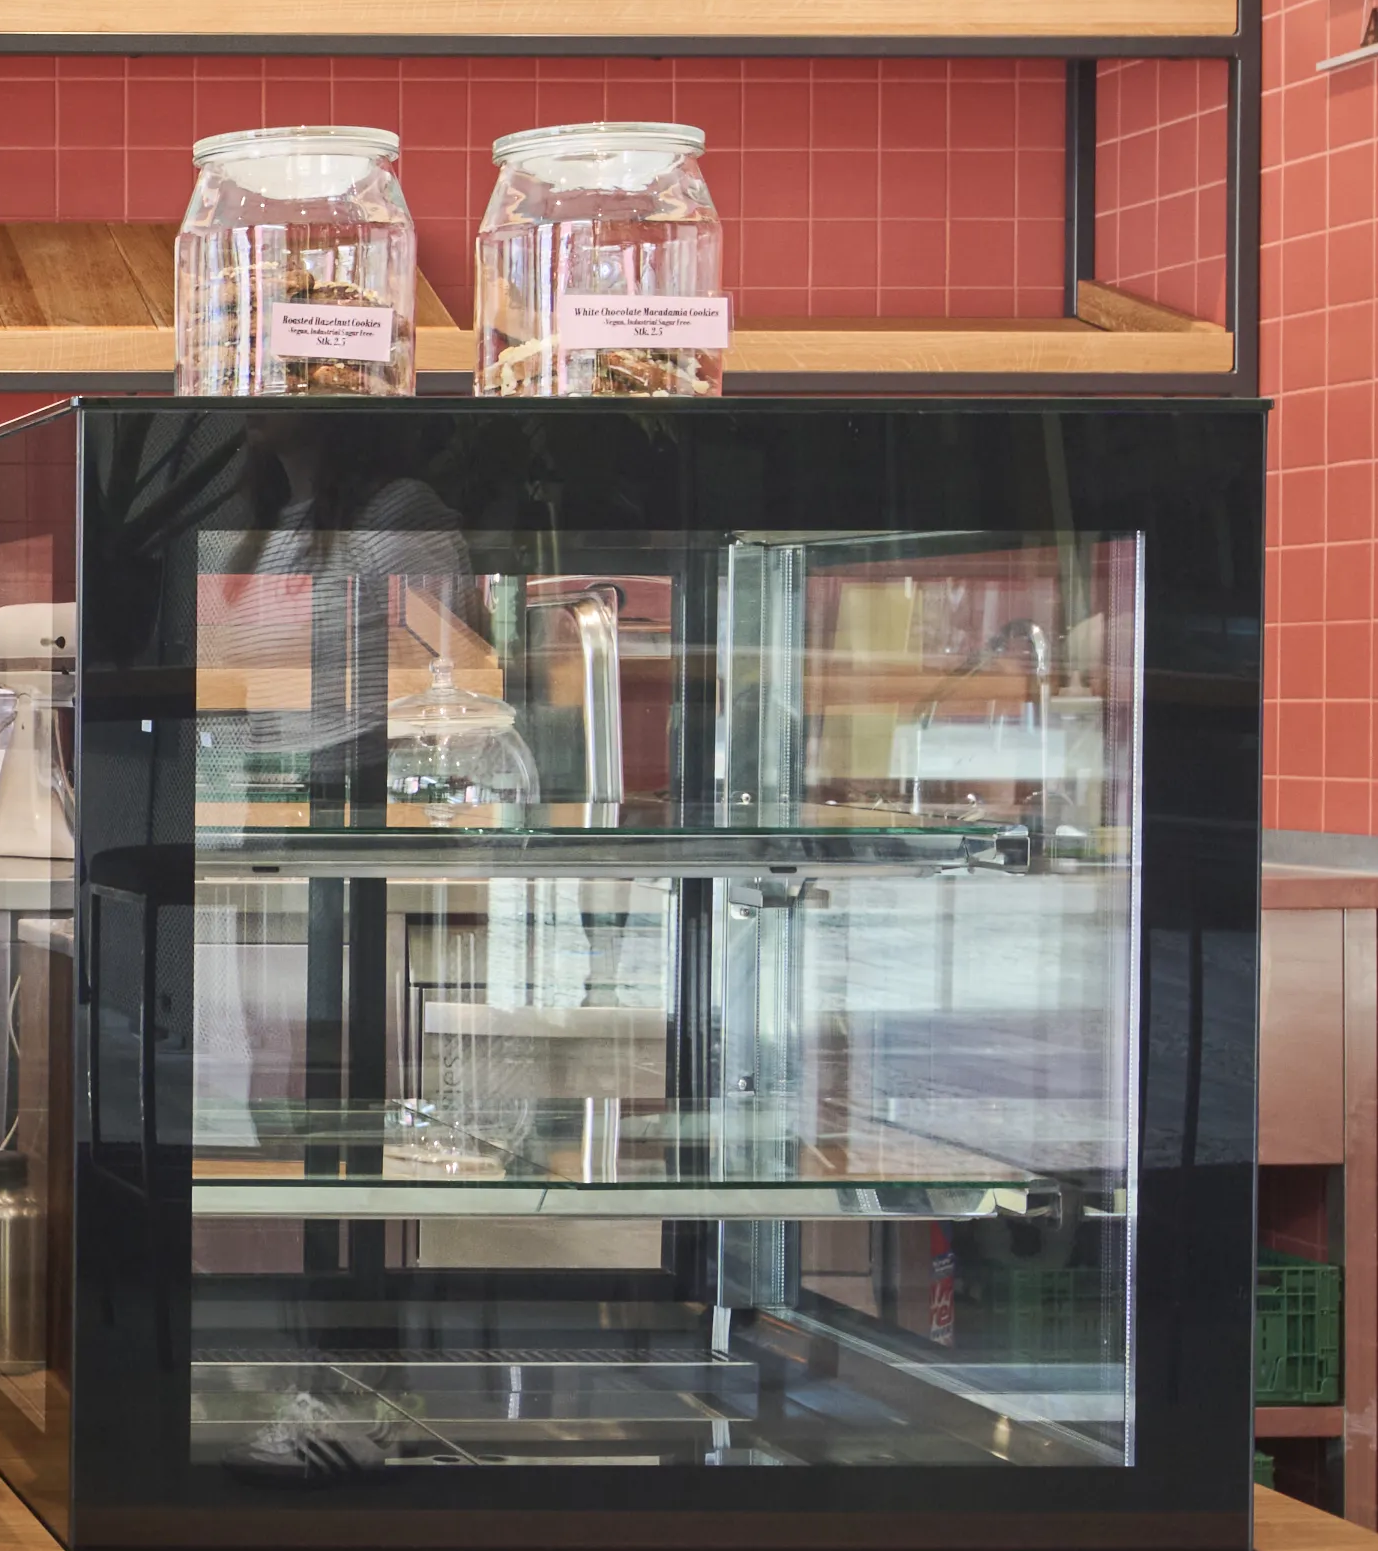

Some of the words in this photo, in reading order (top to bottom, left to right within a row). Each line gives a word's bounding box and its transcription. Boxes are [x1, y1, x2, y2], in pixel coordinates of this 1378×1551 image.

[575, 308, 599, 316] White
[601, 307, 642, 316] Chocolate
[644, 308, 687, 316] Macadamia
[689, 308, 719, 316] Cookies
[283, 316, 313, 325] Roasted
[315, 317, 350, 326] Hazelnut
[352, 318, 381, 328] Cookies
[634, 327, 649, 336] Stk.
[651, 328, 663, 336] 2.5
